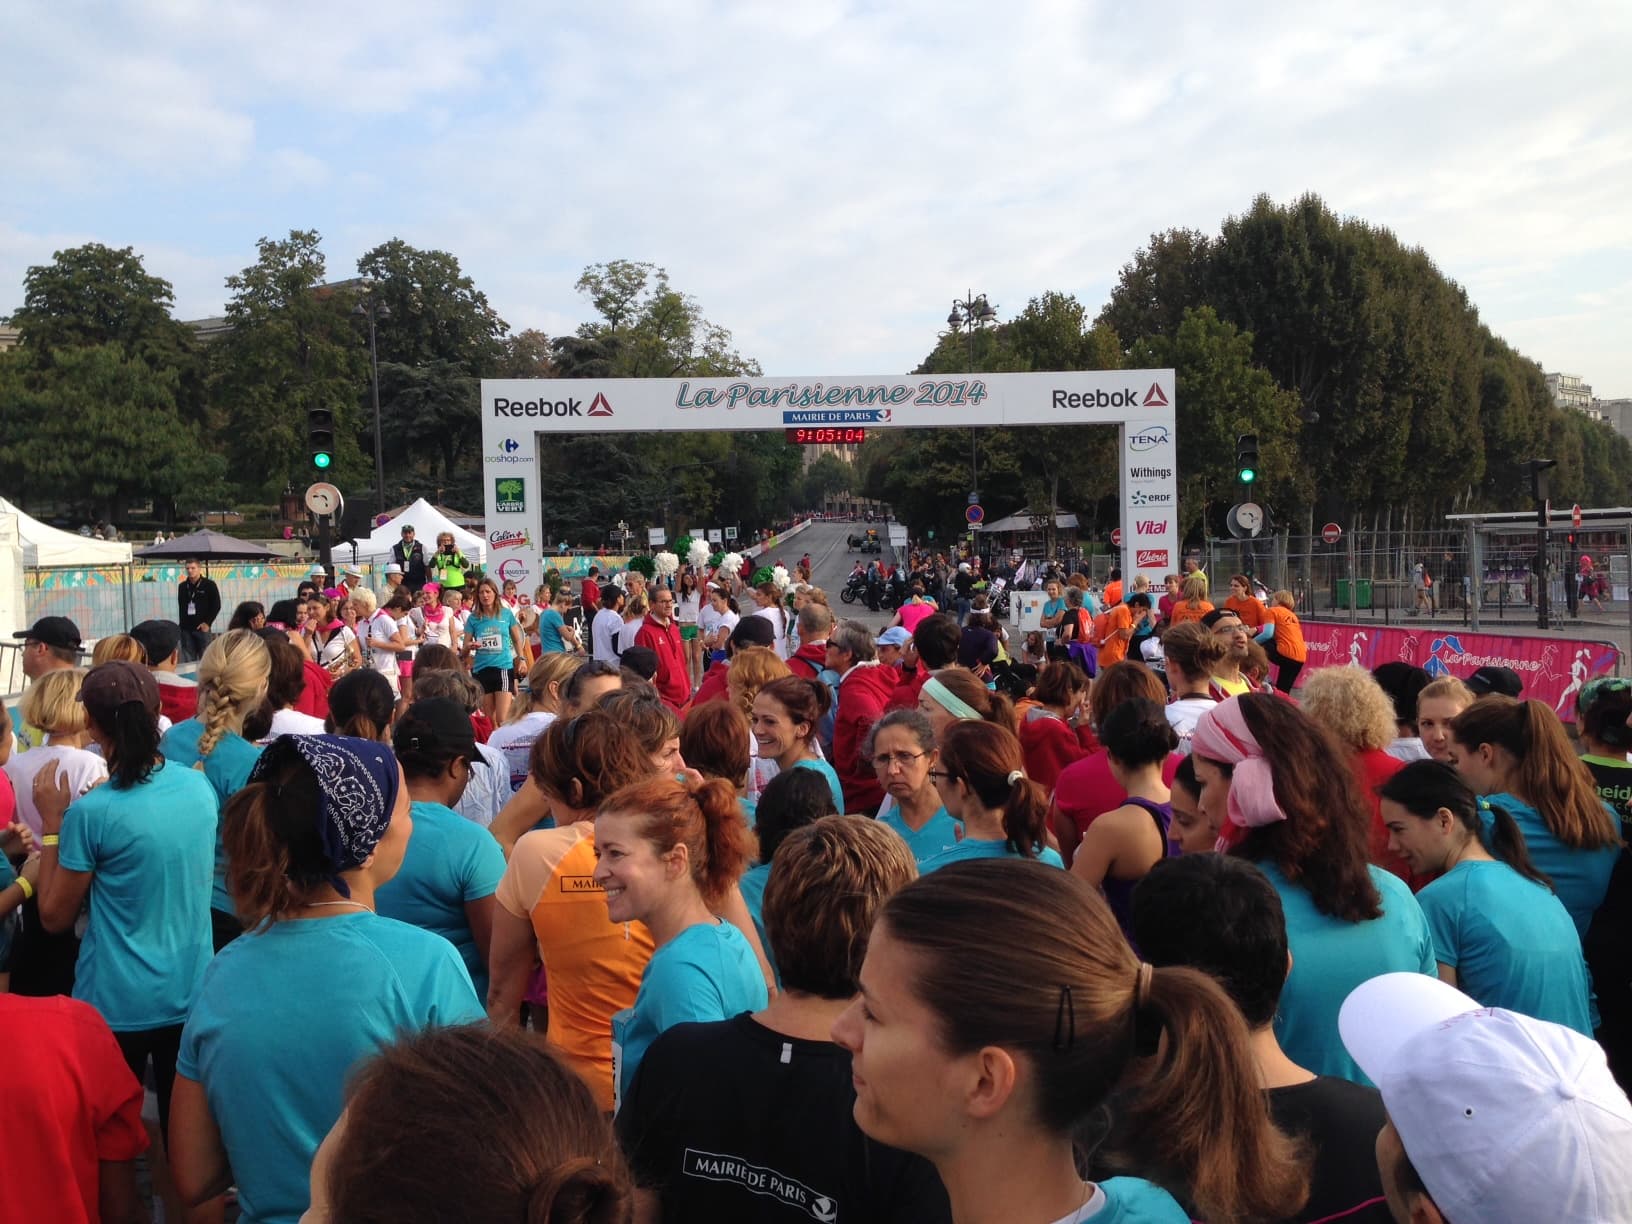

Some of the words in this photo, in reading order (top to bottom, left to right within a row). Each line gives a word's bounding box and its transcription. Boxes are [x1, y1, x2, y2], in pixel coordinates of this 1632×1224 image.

[676, 382, 727, 409] La
[727, 382, 915, 409] Parisienne
[914, 380, 987, 406] 2014
[1052, 388, 1138, 408] Reebok
[494, 398, 583, 417] Reebok
[791, 412, 826, 422] MAIRIE
[828, 412, 842, 421] DE
[844, 411, 871, 421] PARIS
[1129, 435, 1168, 445] TENA
[1130, 467, 1172, 480] Withings
[1136, 520, 1167, 535] Vital
[1443, 650, 1463, 665] La
[695, 1157, 748, 1180] MAIRIE
[747, 1171, 767, 1188] DE
[769, 1176, 807, 1204] PARIS
